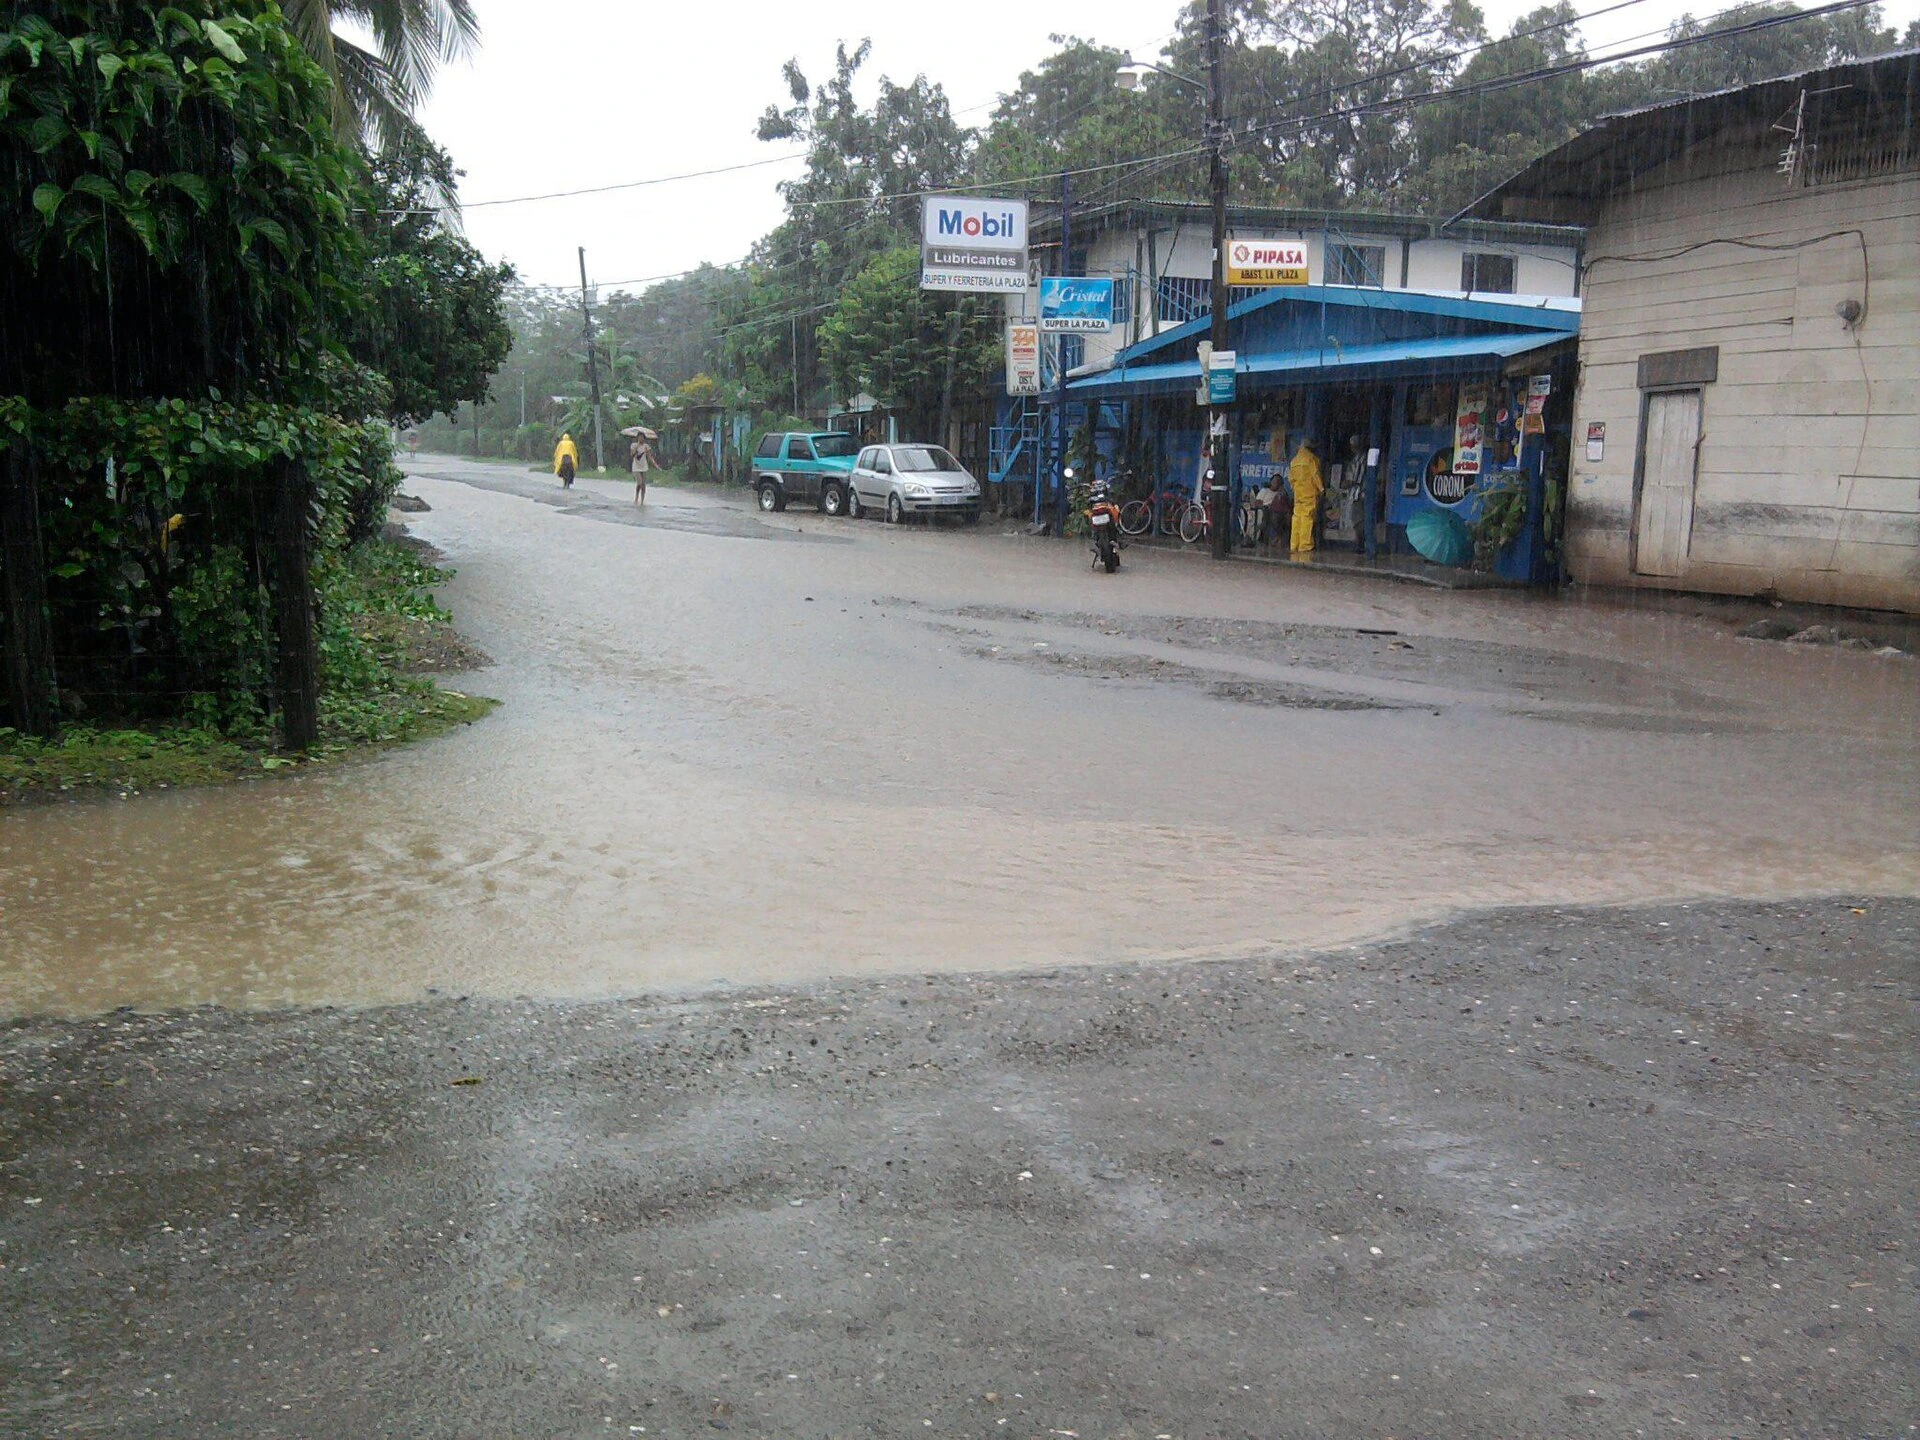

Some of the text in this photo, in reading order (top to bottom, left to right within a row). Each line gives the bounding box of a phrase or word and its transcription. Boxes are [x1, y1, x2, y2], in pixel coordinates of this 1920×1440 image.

[938, 209, 1014, 237] Mobil
[934, 251, 1017, 266] Lubricantes
[1252, 250, 1303, 264] PIPASA
[924, 273, 1026, 288] SUPER Y FERRETERIA LA PLAZA
[1266, 269, 1274, 279] LA
[1277, 269, 1299, 279] PLAZA
[1060, 286, 1108, 303] Cristal
[1044, 319, 1069, 328] SUPER
[1071, 320, 1080, 328] LA
[1082, 320, 1106, 329] PLAZA
[1433, 475, 1465, 497] CORONA
